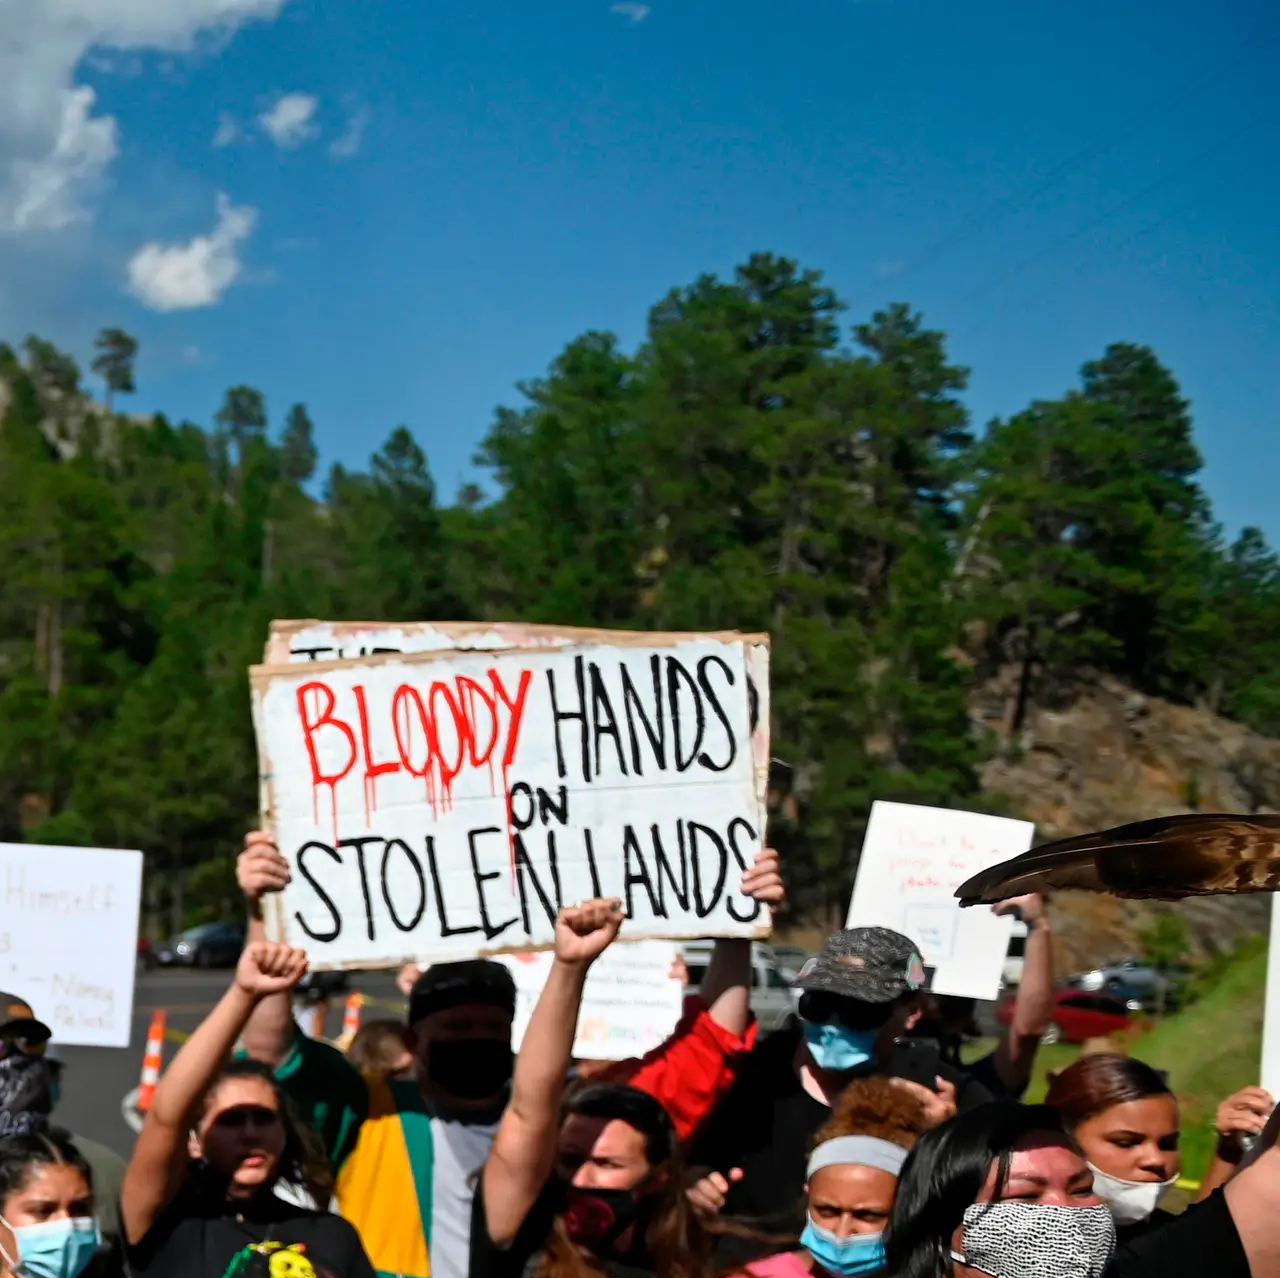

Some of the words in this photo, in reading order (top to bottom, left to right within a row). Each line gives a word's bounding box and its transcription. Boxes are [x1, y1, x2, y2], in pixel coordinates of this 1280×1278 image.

[296, 667, 533, 790] BLOODY
[545, 653, 738, 783] HANDS
[510, 781, 569, 830] ON
[295, 827, 559, 941] STOLEN
